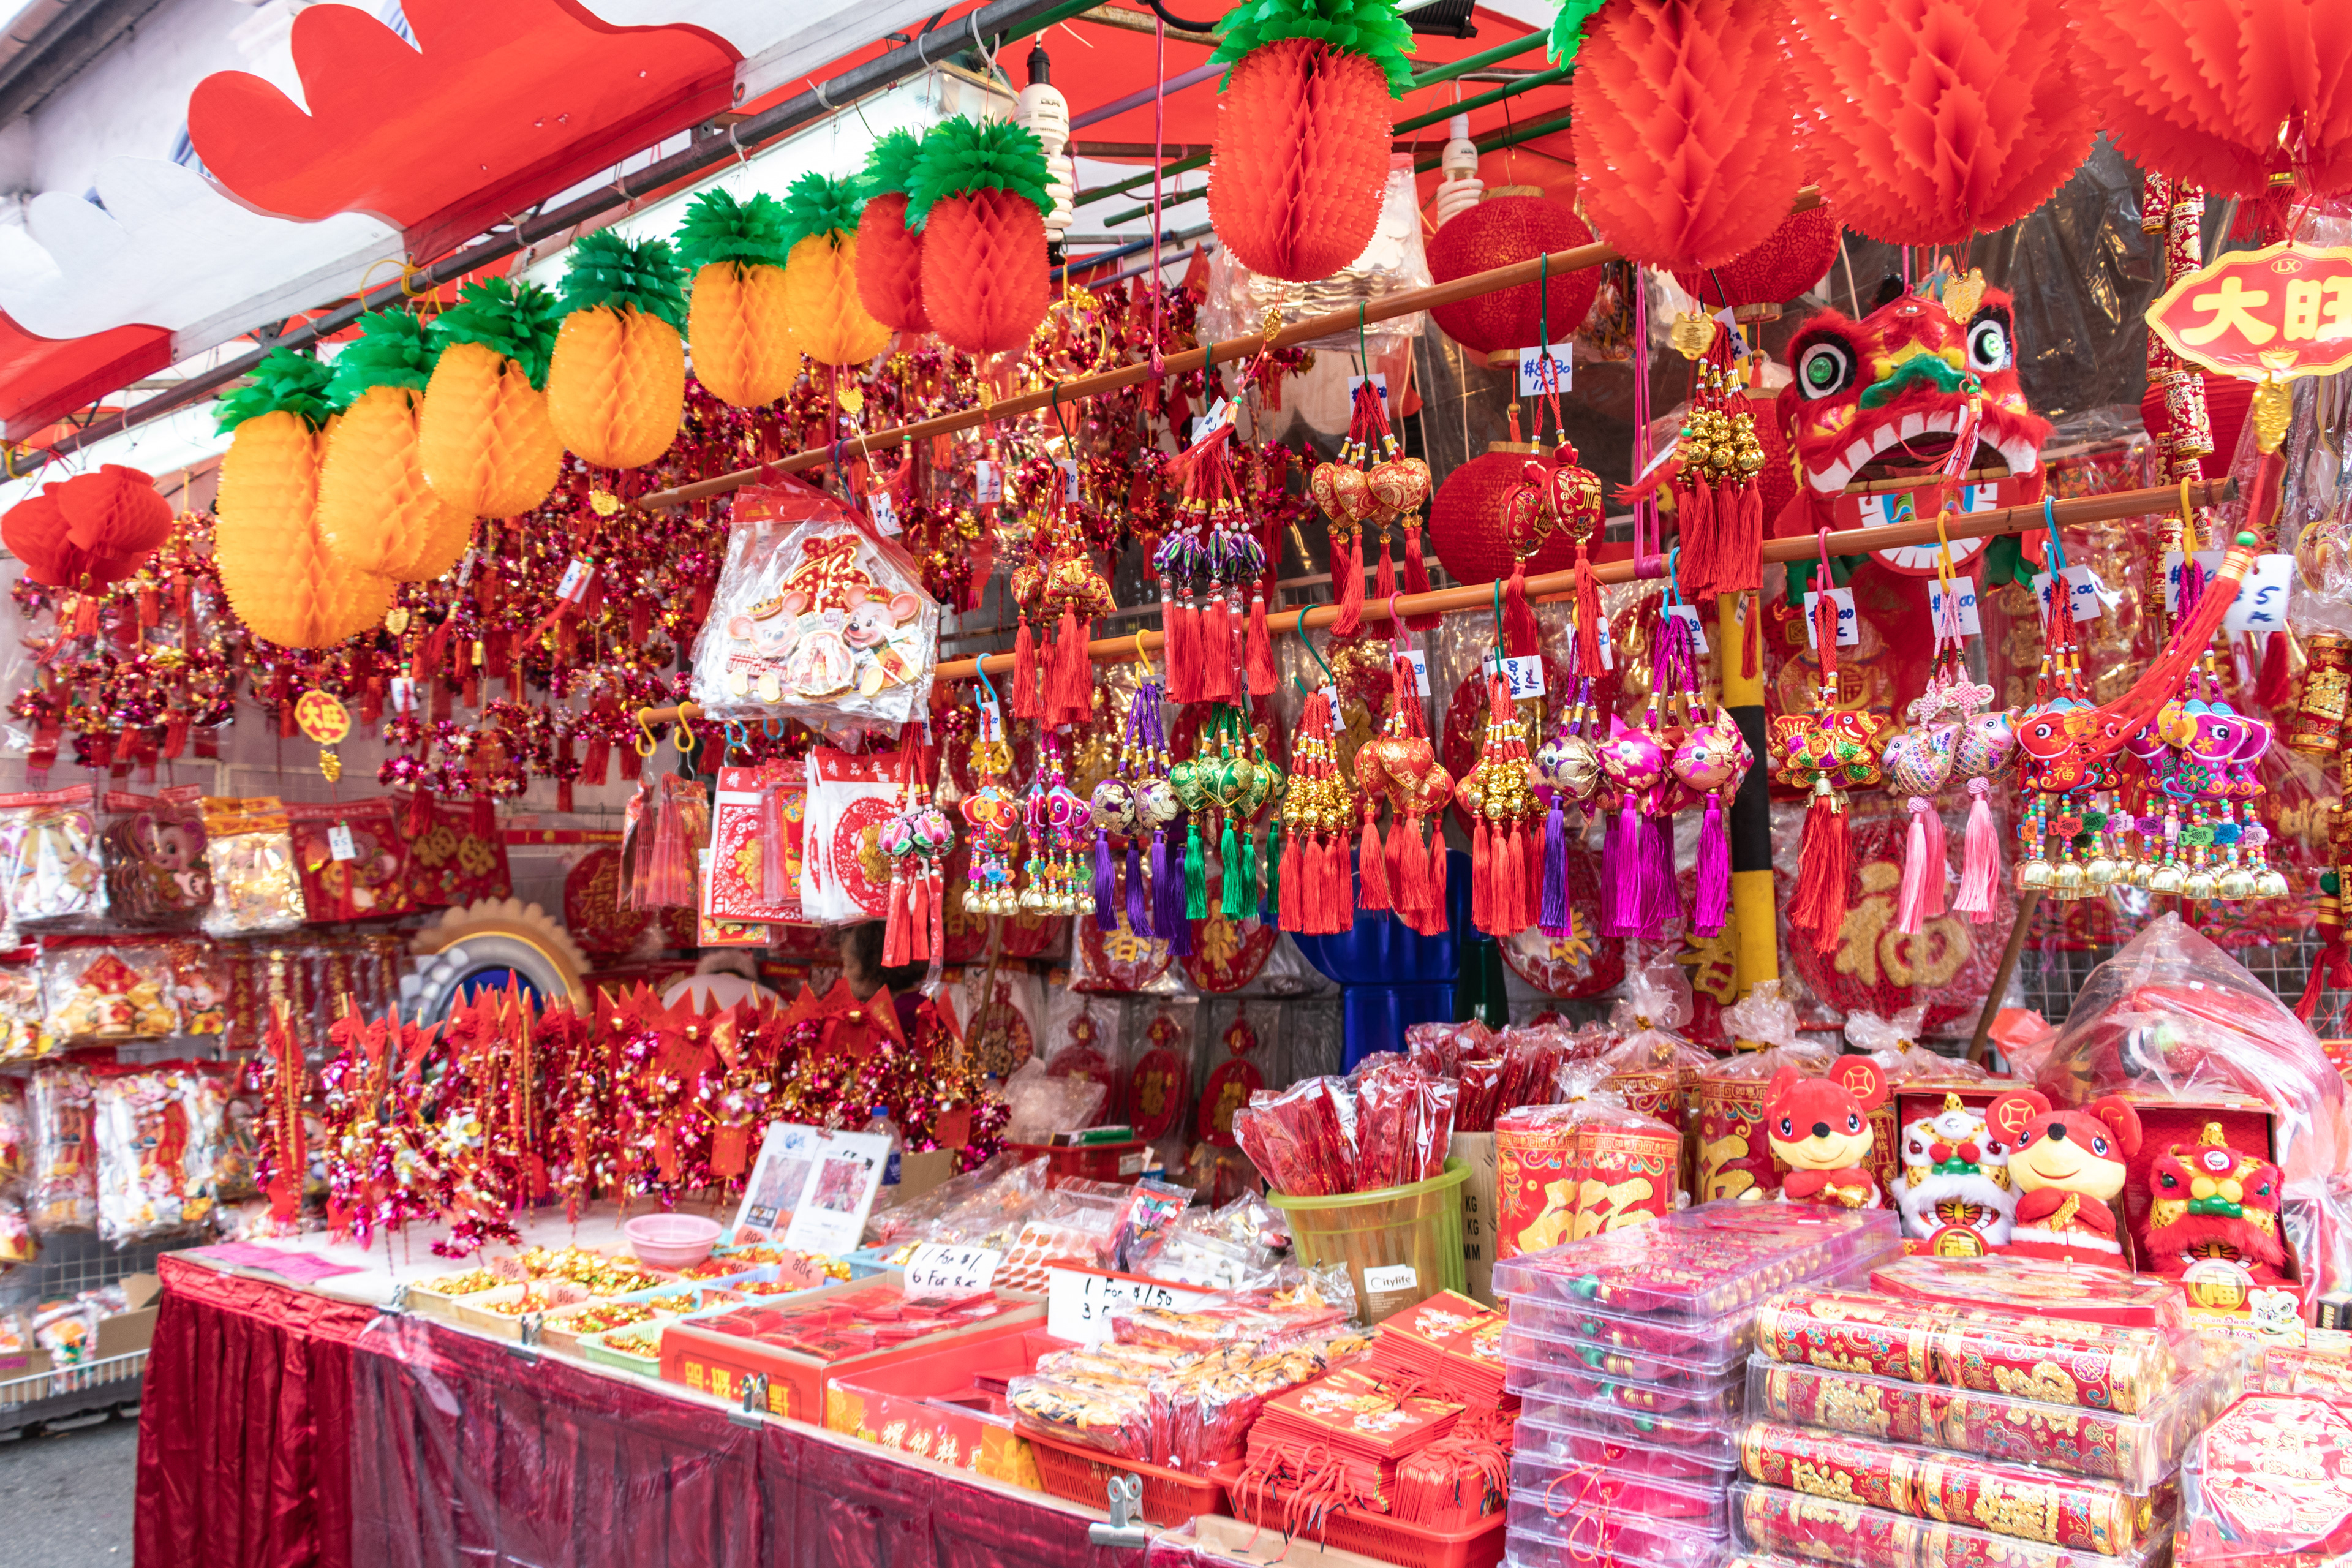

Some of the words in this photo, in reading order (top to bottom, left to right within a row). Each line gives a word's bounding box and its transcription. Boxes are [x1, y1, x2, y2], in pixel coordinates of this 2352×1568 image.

[2277, 261, 2296, 272] LX
[2179, 275, 2352, 346] 大旺
[302, 701, 345, 731] 大旺
[1811, 738, 1826, 754] 福
[2053, 761, 2076, 781] 福
[1102, 908, 1152, 963] 春
[1875, 1117, 1890, 1164] 五福临门
[1466, 1196, 1477, 1212] KG
[1468, 1218, 1479, 1235] KG
[1944, 1234, 1977, 1257] 福
[935, 1249, 954, 1265] For
[502, 1260, 519, 1278] 80¢
[792, 1259, 812, 1280] 80¢
[913, 1268, 921, 1284] 6
[928, 1270, 948, 1286] For
[1085, 1277, 1091, 1296] 1
[1104, 1277, 1123, 1298] For
[1371, 1275, 1411, 1289] Citylife
[2200, 1269, 2239, 1306] 福
[557, 1289, 575, 1304] 80¢
[1082, 1302, 1091, 1320] 3
[2201, 1313, 2222, 1324] Lion
[2224, 1316, 2255, 1326] Dance
